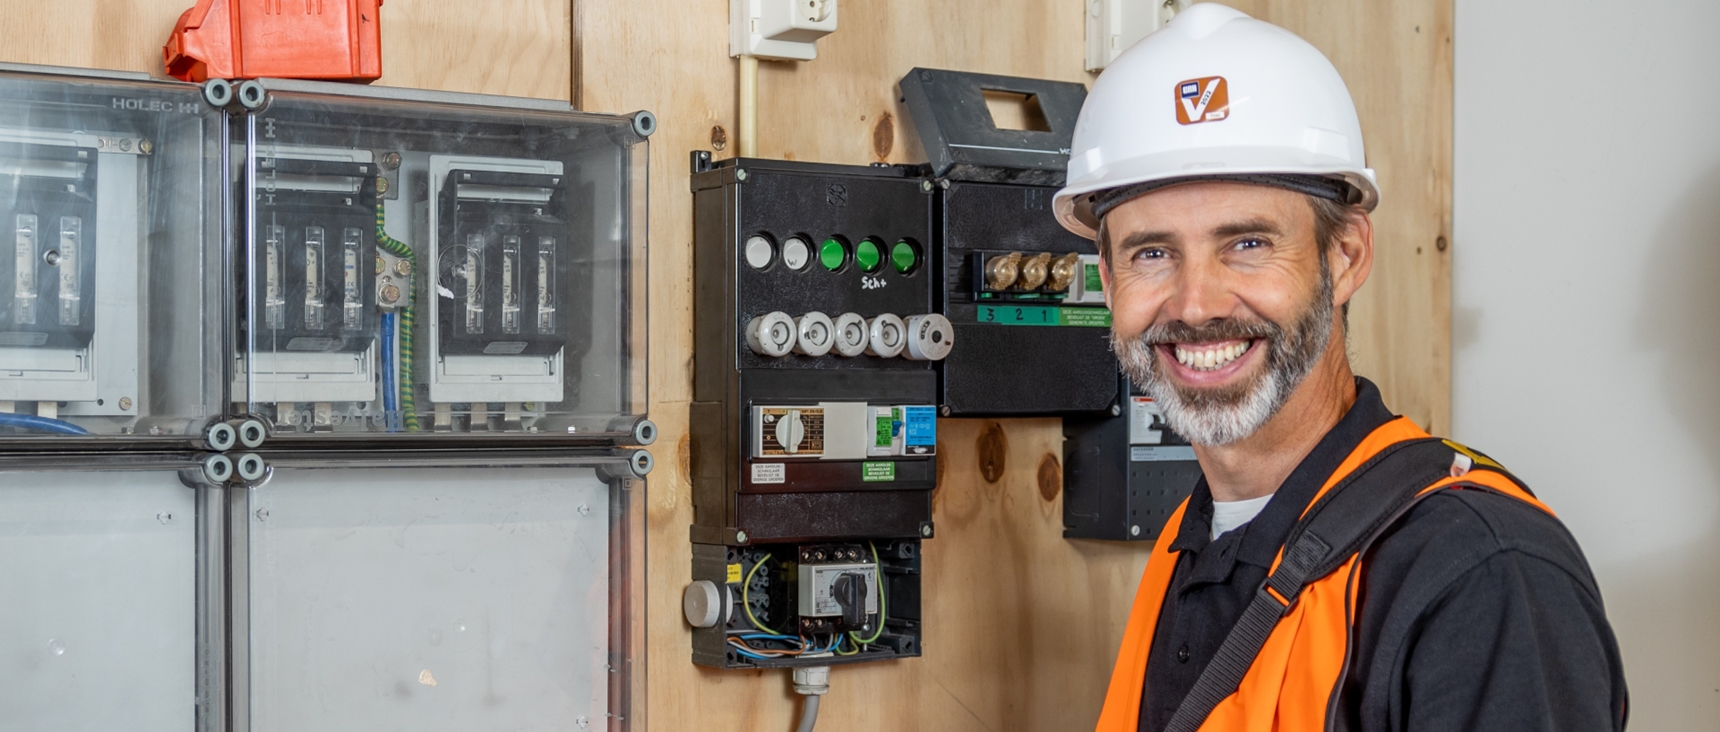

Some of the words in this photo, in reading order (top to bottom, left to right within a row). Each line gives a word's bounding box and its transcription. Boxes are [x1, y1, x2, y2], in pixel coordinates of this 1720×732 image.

[112, 97, 174, 112] HOLEC
[1200, 90, 1212, 106] 2022
[265, 144, 277, 206] HOLEC
[986, 307, 994, 322] 3
[1015, 307, 1024, 321] 2
[1041, 309, 1047, 322] 1
